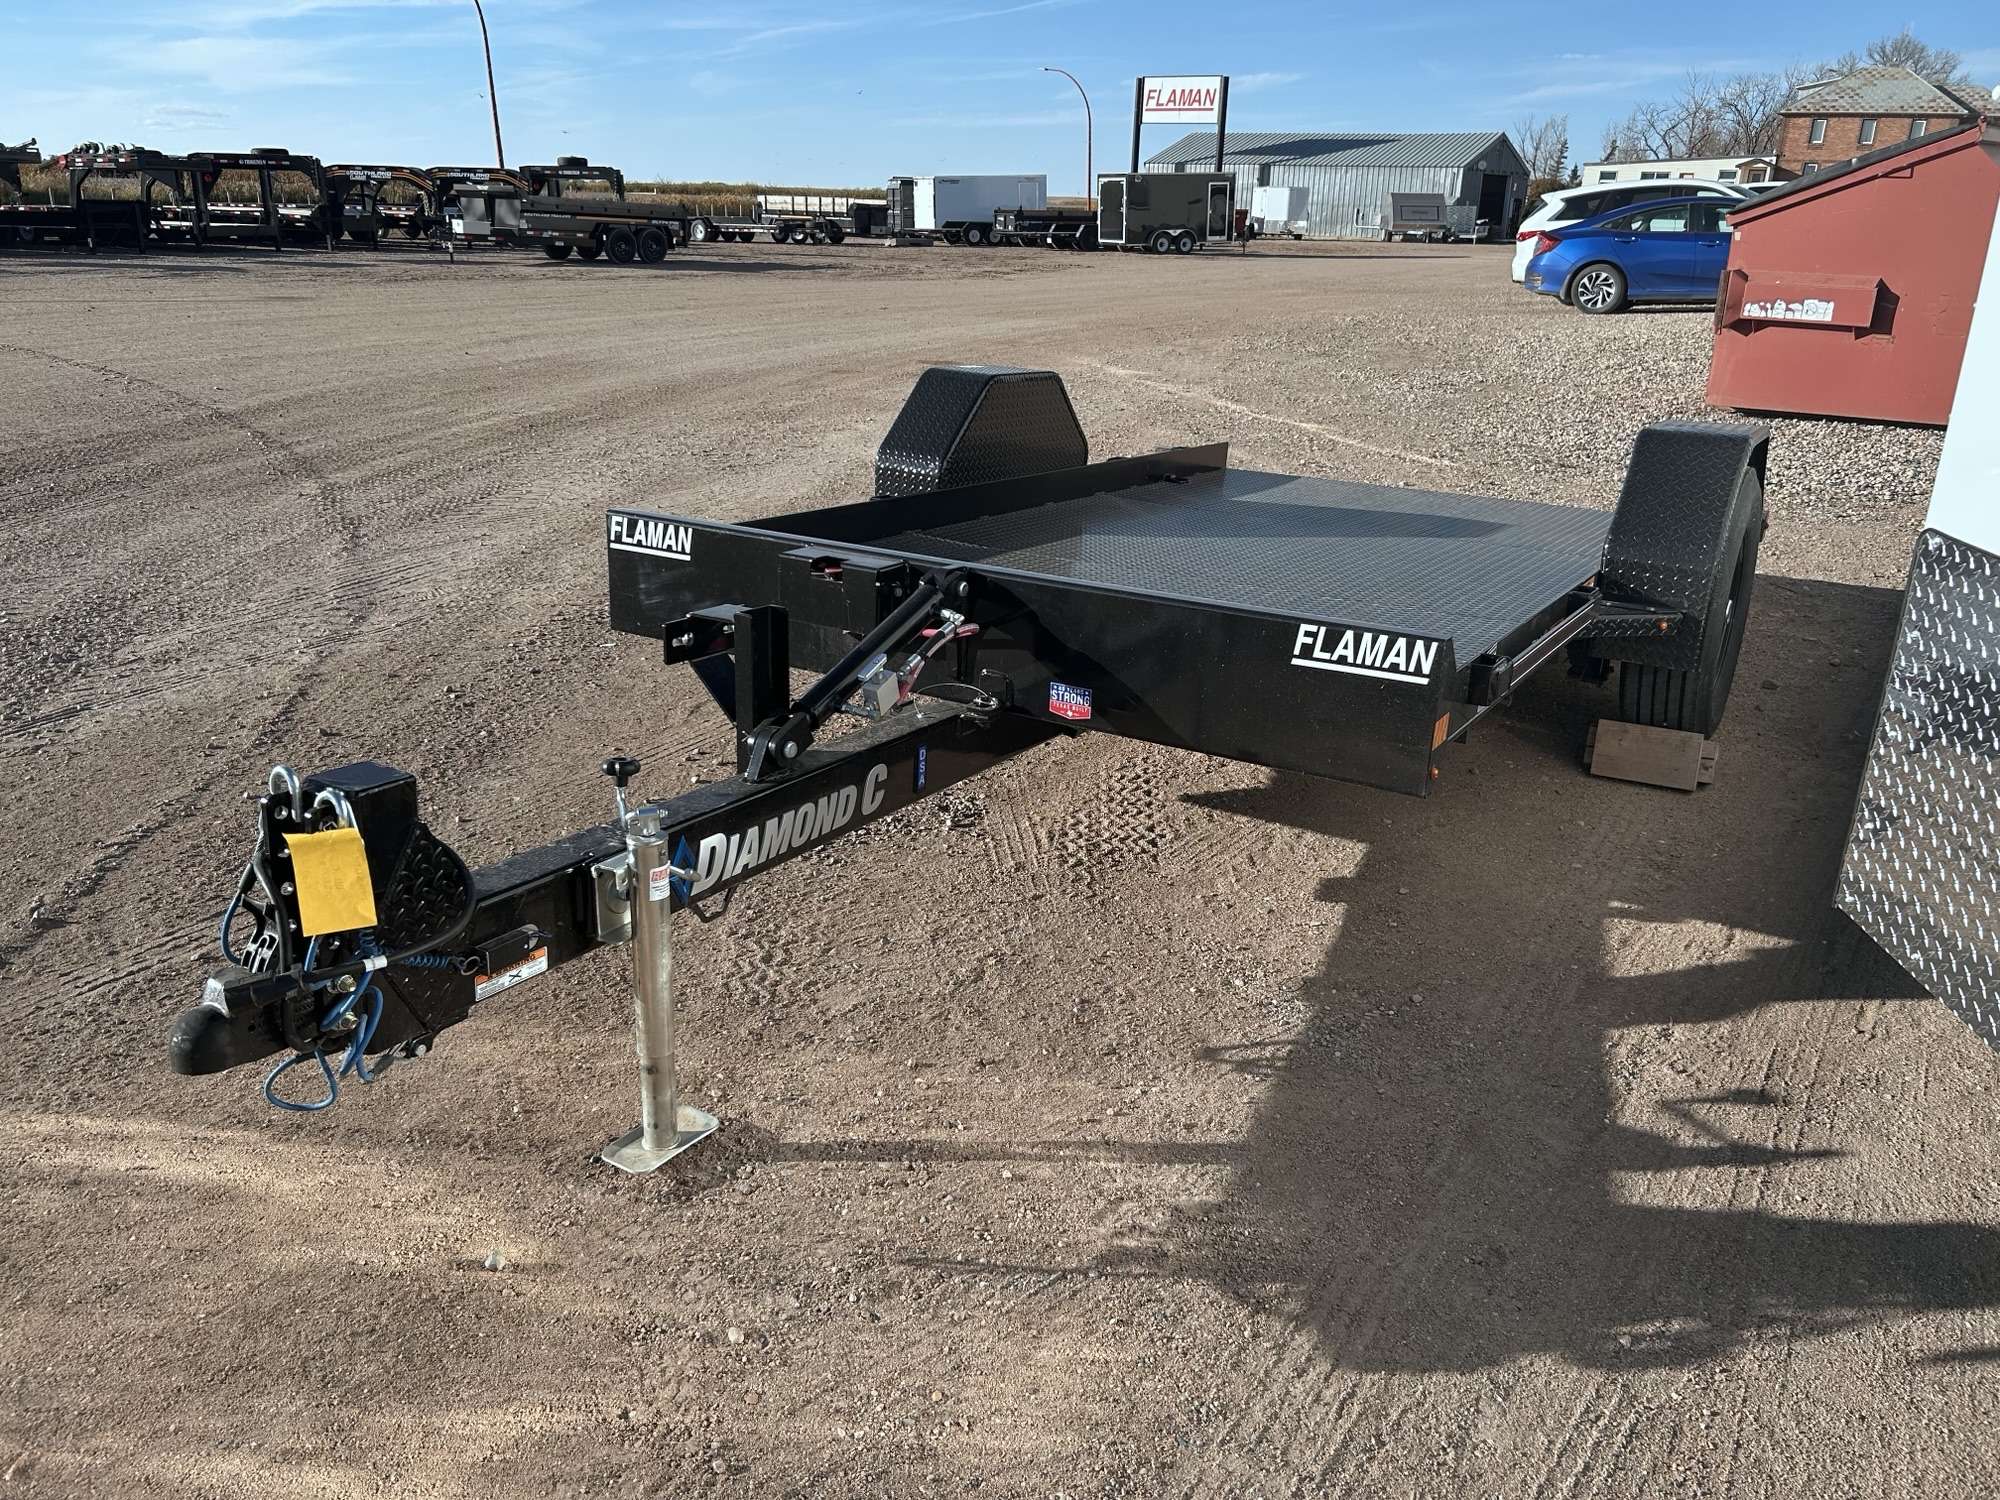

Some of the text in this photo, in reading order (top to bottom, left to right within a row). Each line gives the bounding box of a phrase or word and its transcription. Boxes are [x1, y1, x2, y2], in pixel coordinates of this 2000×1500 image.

[1146, 88, 1217, 107] FLAMAN
[610, 515, 693, 554] FLAMAN
[1293, 623, 1439, 675] FLAMAN
[1052, 690, 1090, 706] STRONG
[918, 749, 927, 785] DSA
[690, 763, 888, 896] DIAMOND C
